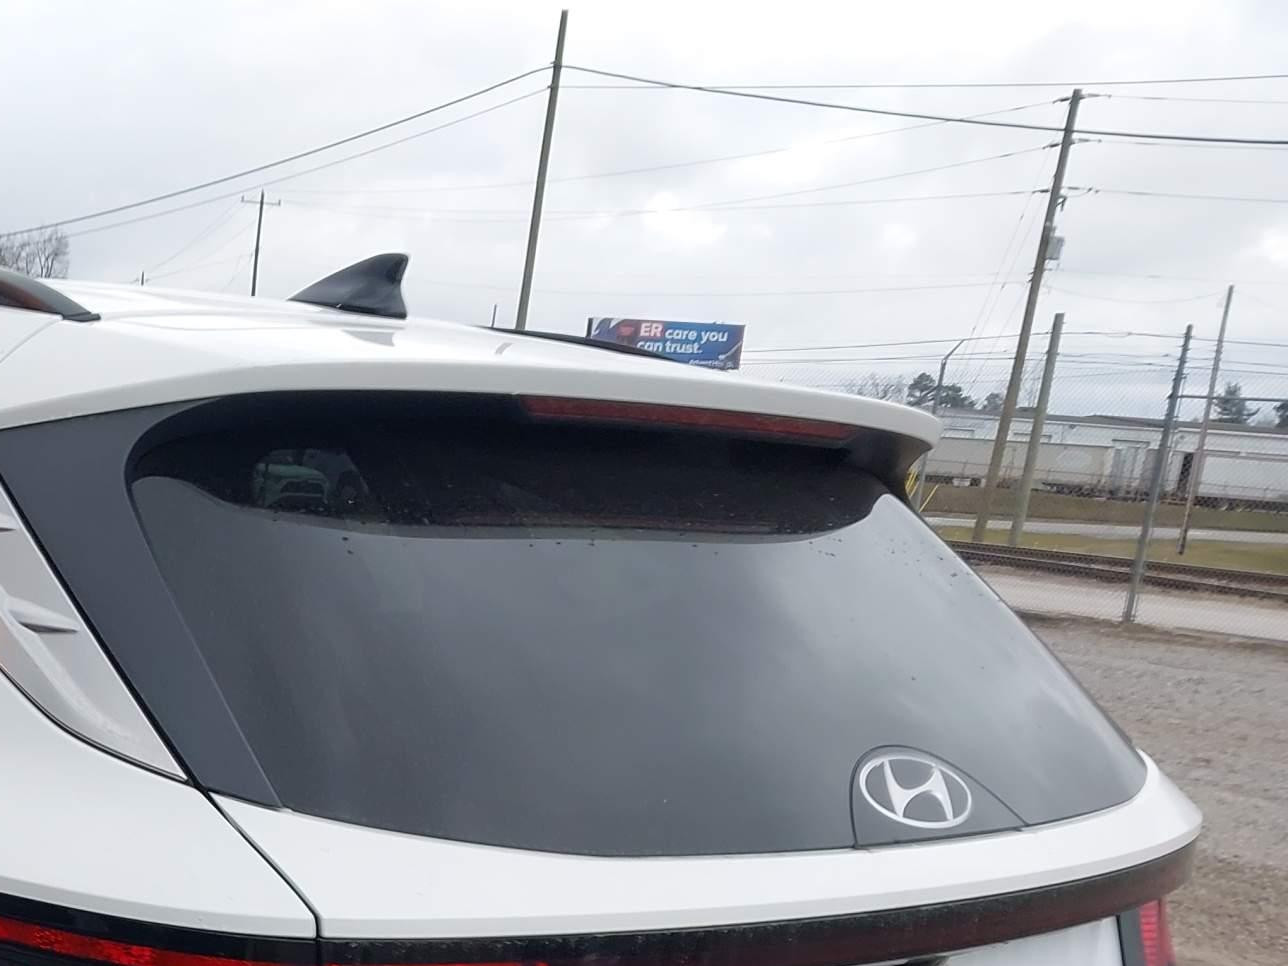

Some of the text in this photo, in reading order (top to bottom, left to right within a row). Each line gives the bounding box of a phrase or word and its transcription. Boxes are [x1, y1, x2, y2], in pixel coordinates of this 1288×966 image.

[639, 322, 729, 345] ER care you
[636, 340, 704, 354] can trust.
